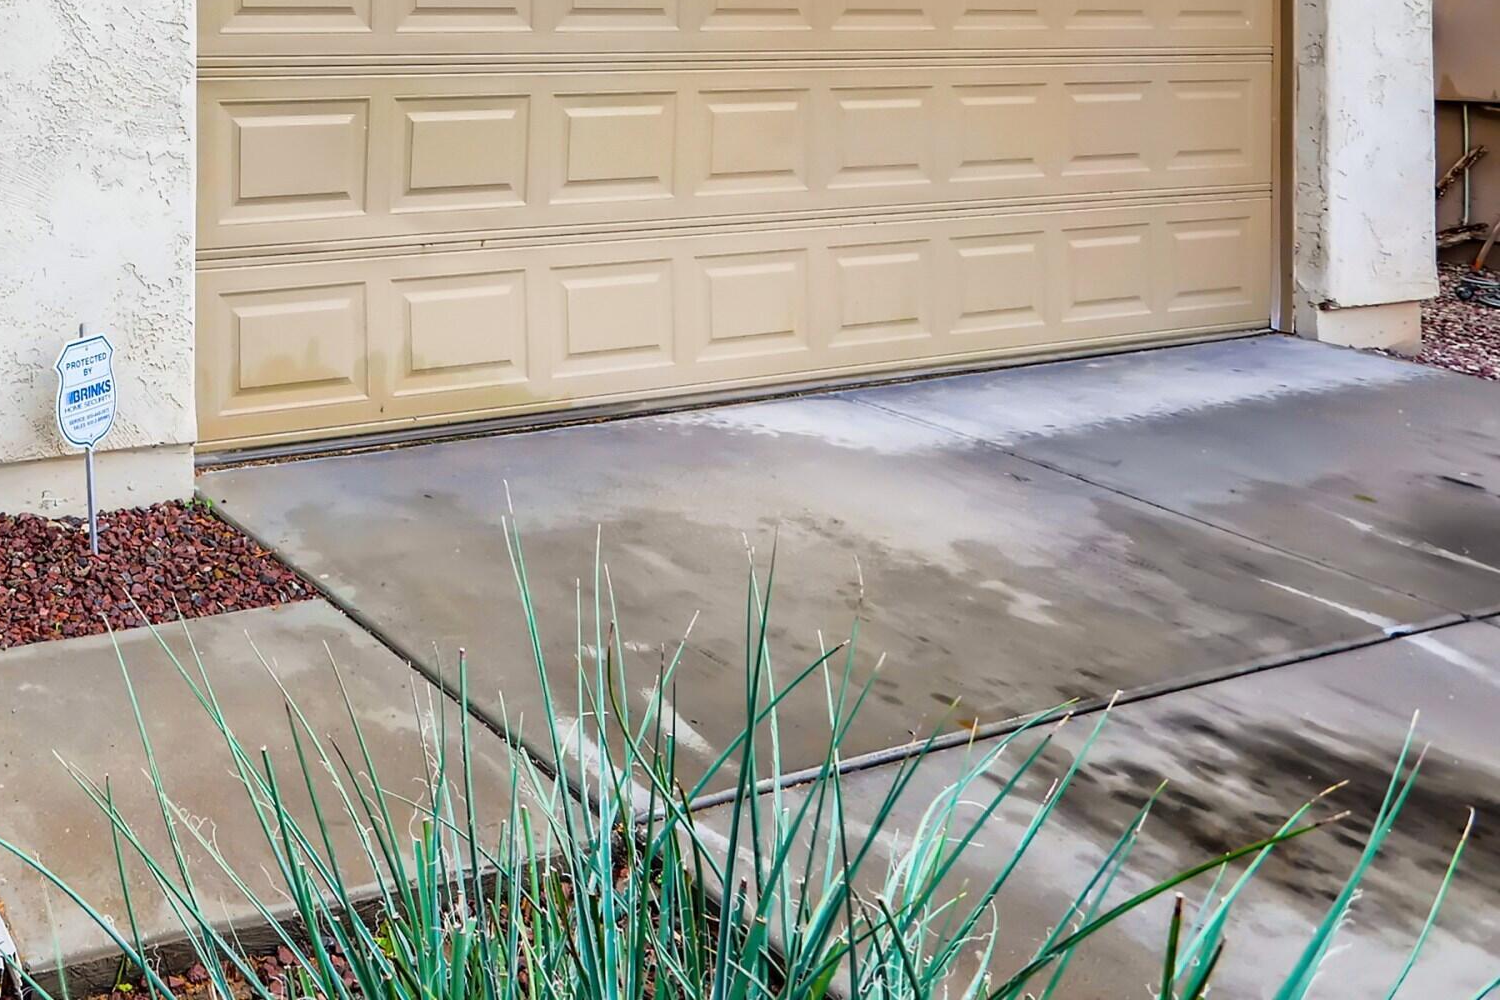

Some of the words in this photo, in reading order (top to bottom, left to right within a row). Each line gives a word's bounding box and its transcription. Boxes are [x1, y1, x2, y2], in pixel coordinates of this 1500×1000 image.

[66, 352, 107, 370] PROTECTED
[83, 367, 93, 376] BY
[73, 379, 111, 403] BRINKS
